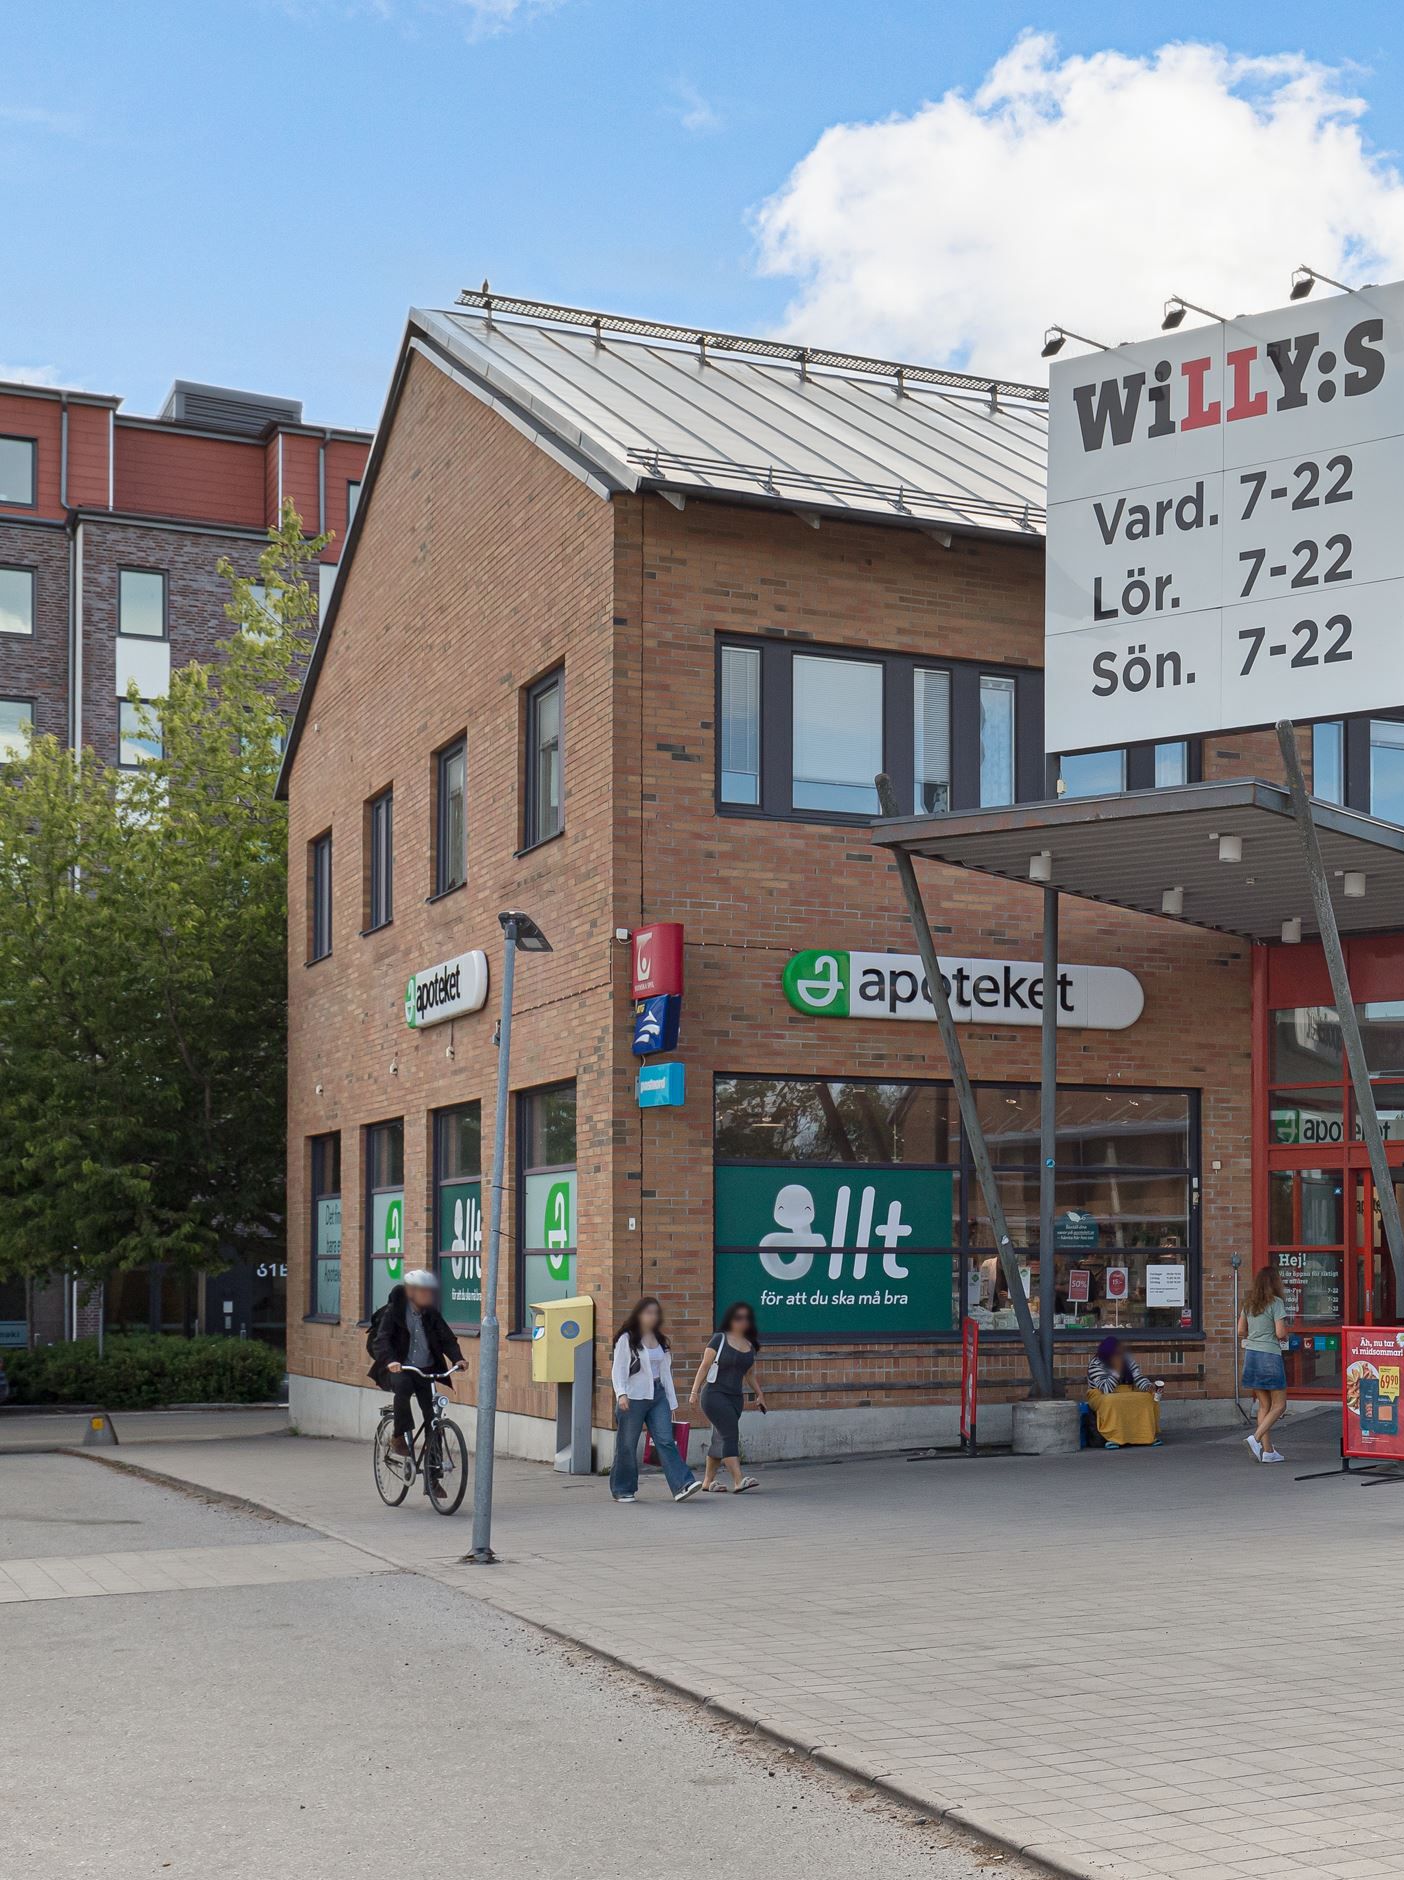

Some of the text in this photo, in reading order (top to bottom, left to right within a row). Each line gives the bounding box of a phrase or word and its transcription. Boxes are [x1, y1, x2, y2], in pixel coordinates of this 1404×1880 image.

[1093, 454, 1353, 546] Vard. 7-22
[1093, 533, 1353, 622] Lör. 7-22
[1091, 613, 1353, 697] Sön. 7-22
[416, 963, 461, 1020] apoteket
[1279, 1253, 1307, 1268] Hej!
[761, 1290, 909, 1305] för att du ska må bra
